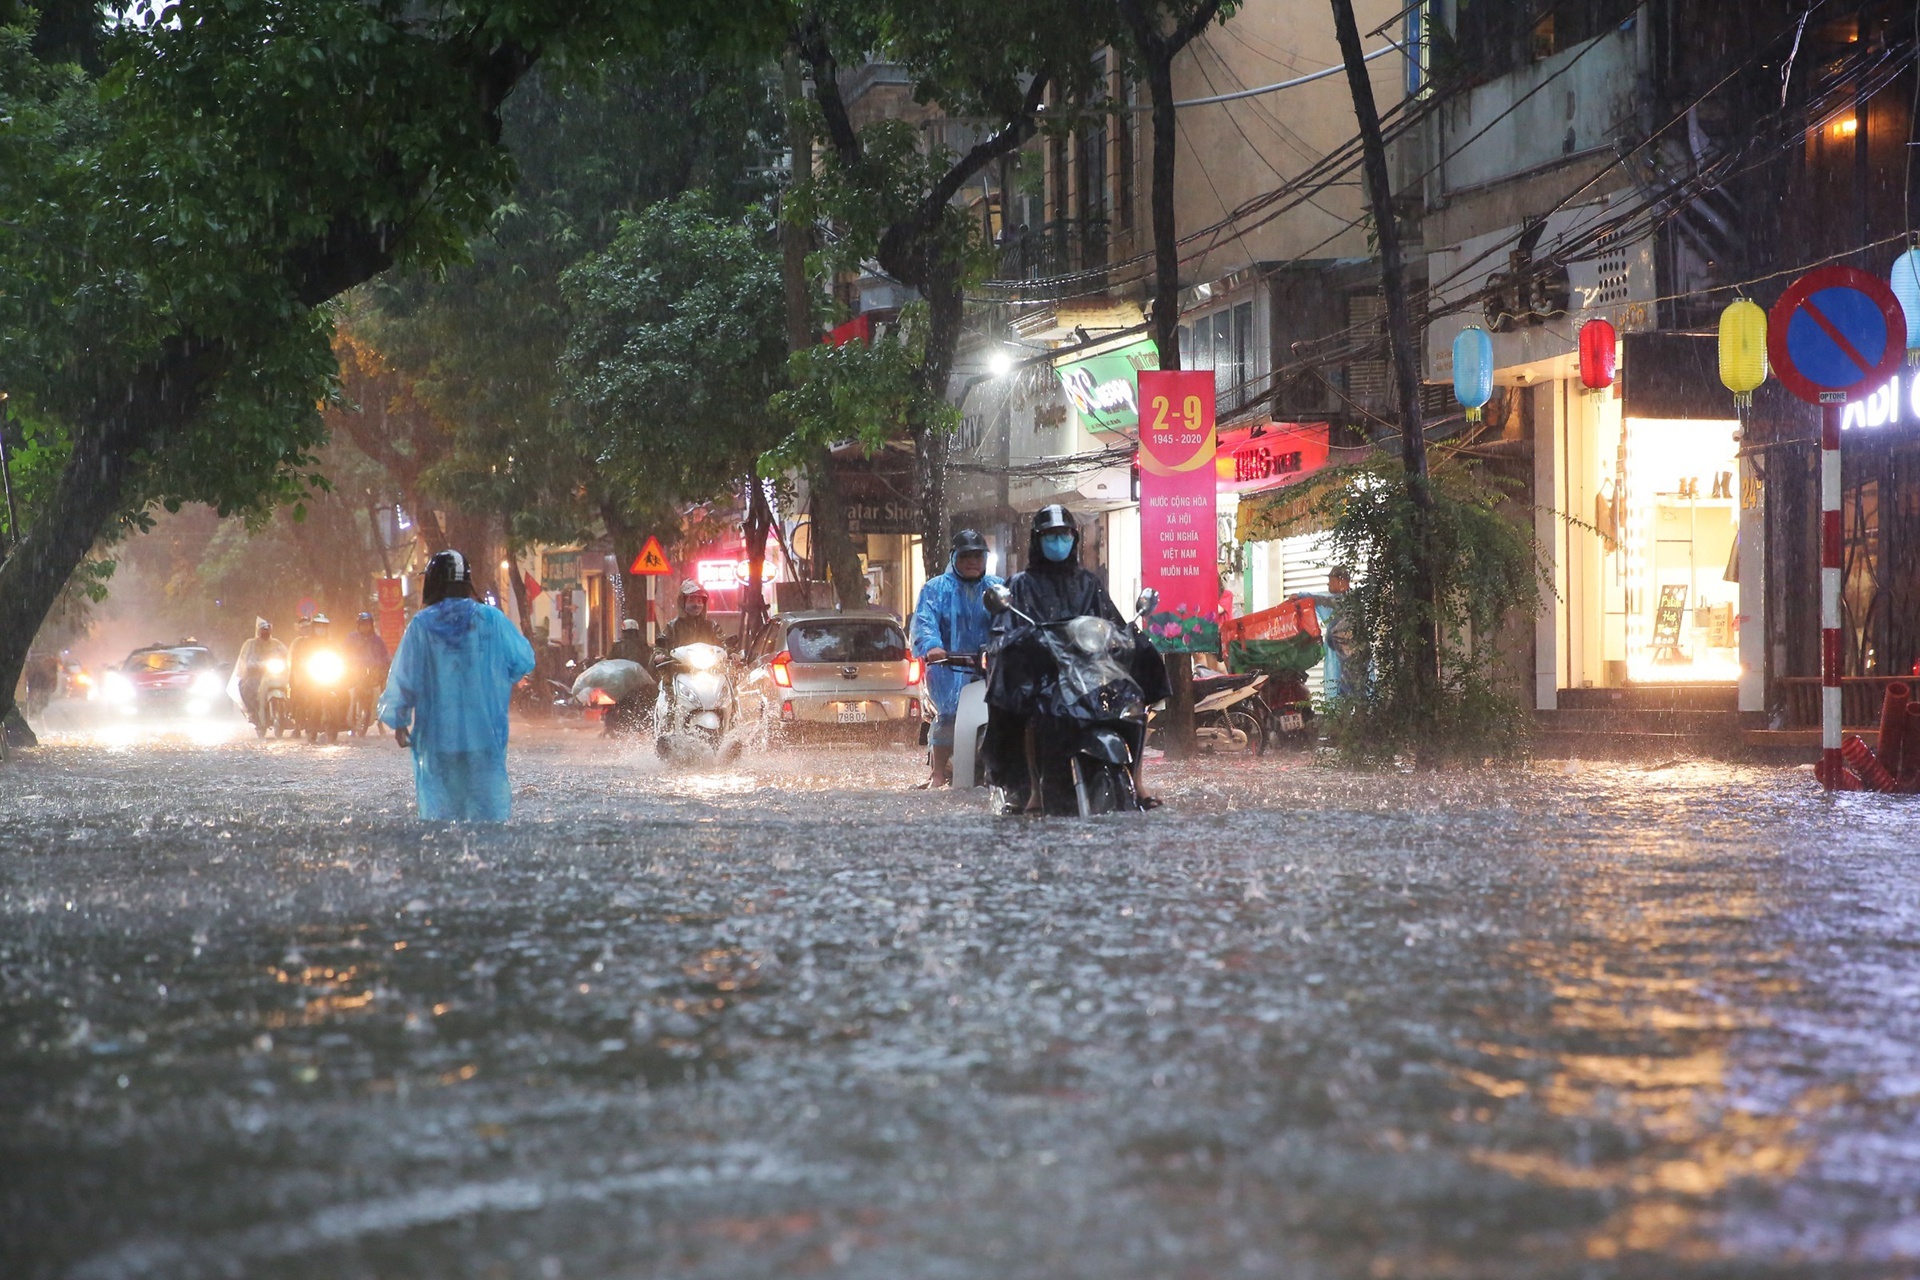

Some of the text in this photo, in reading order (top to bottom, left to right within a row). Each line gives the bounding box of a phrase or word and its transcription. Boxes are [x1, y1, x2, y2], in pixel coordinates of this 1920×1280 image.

[1820, 392, 1845, 400] OPTONE
[1152, 395, 1202, 430] 2-9
[1153, 434, 1174, 444] 1945
[1181, 434, 1202, 444] 2020
[1149, 494, 1169, 507] NƯỚC
[1171, 494, 1190, 508] CỘNG
[1167, 512, 1191, 525] XÃ HỘI
[1160, 528, 1199, 542] CHỦ NGHĨA
[1162, 547, 1197, 560] VIỆT NAM
[1160, 564, 1200, 576] MUÔN NĂM
[844, 703, 860, 713] 30E
